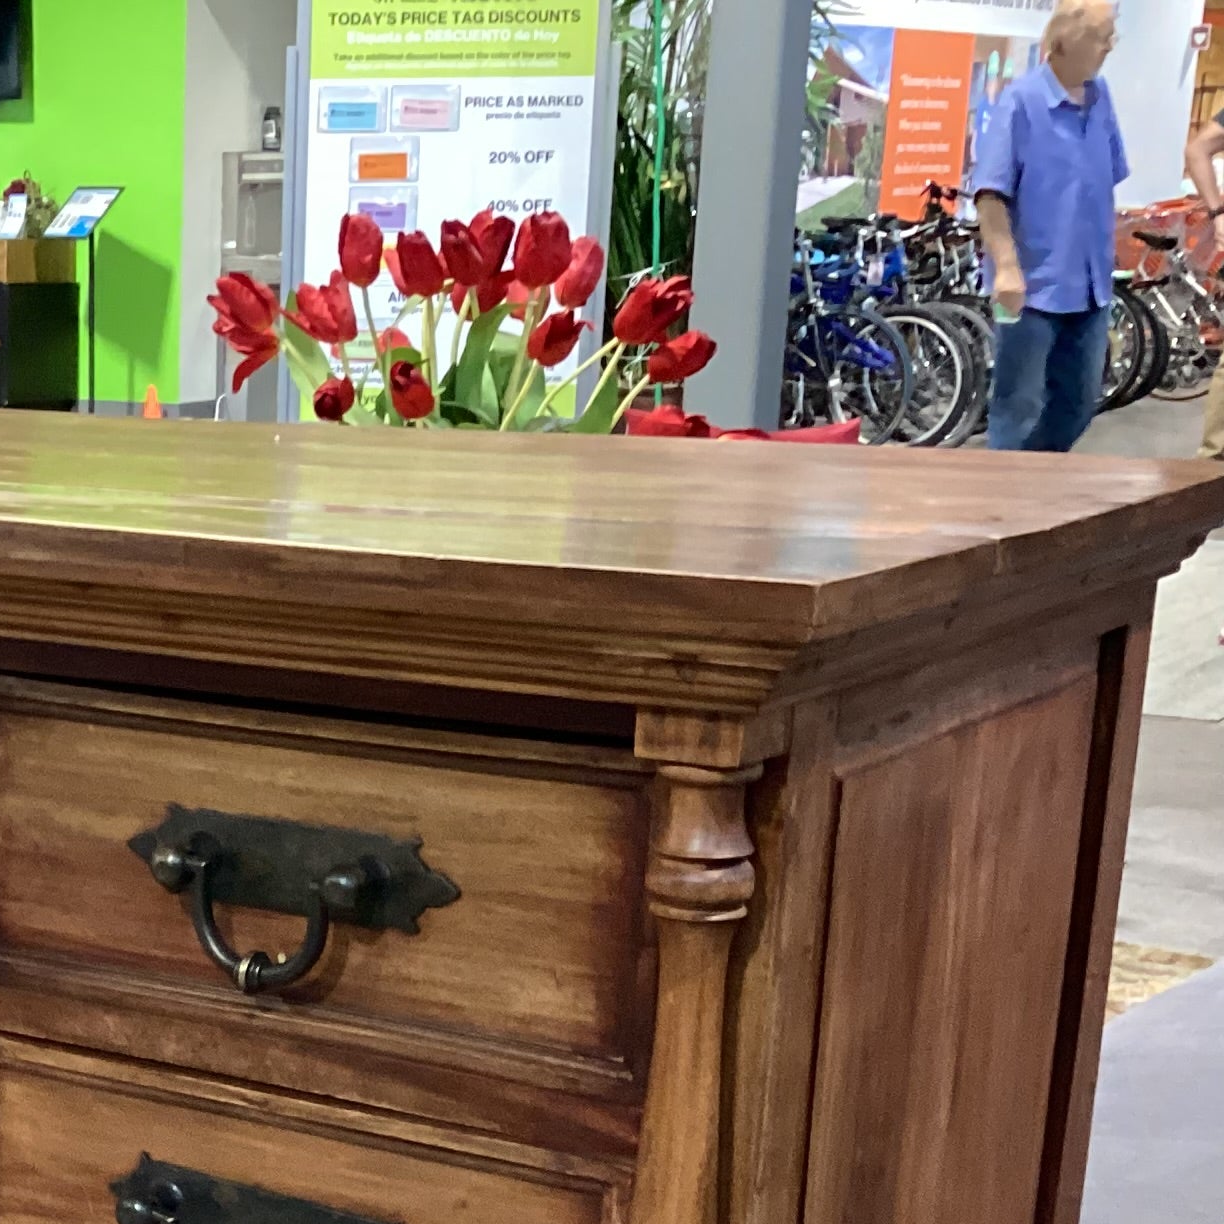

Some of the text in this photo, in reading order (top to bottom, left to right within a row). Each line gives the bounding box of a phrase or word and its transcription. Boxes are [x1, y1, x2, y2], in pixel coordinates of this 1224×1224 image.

[328, 9, 581, 26] TODAY'S PRICE TAG DISCOUNTS
[424, 28, 512, 42] DESCUENTO
[464, 95, 584, 108] PRICE AS MARKED
[489, 150, 555, 164] 20% OFF
[487, 198, 552, 213] 40% OFF
